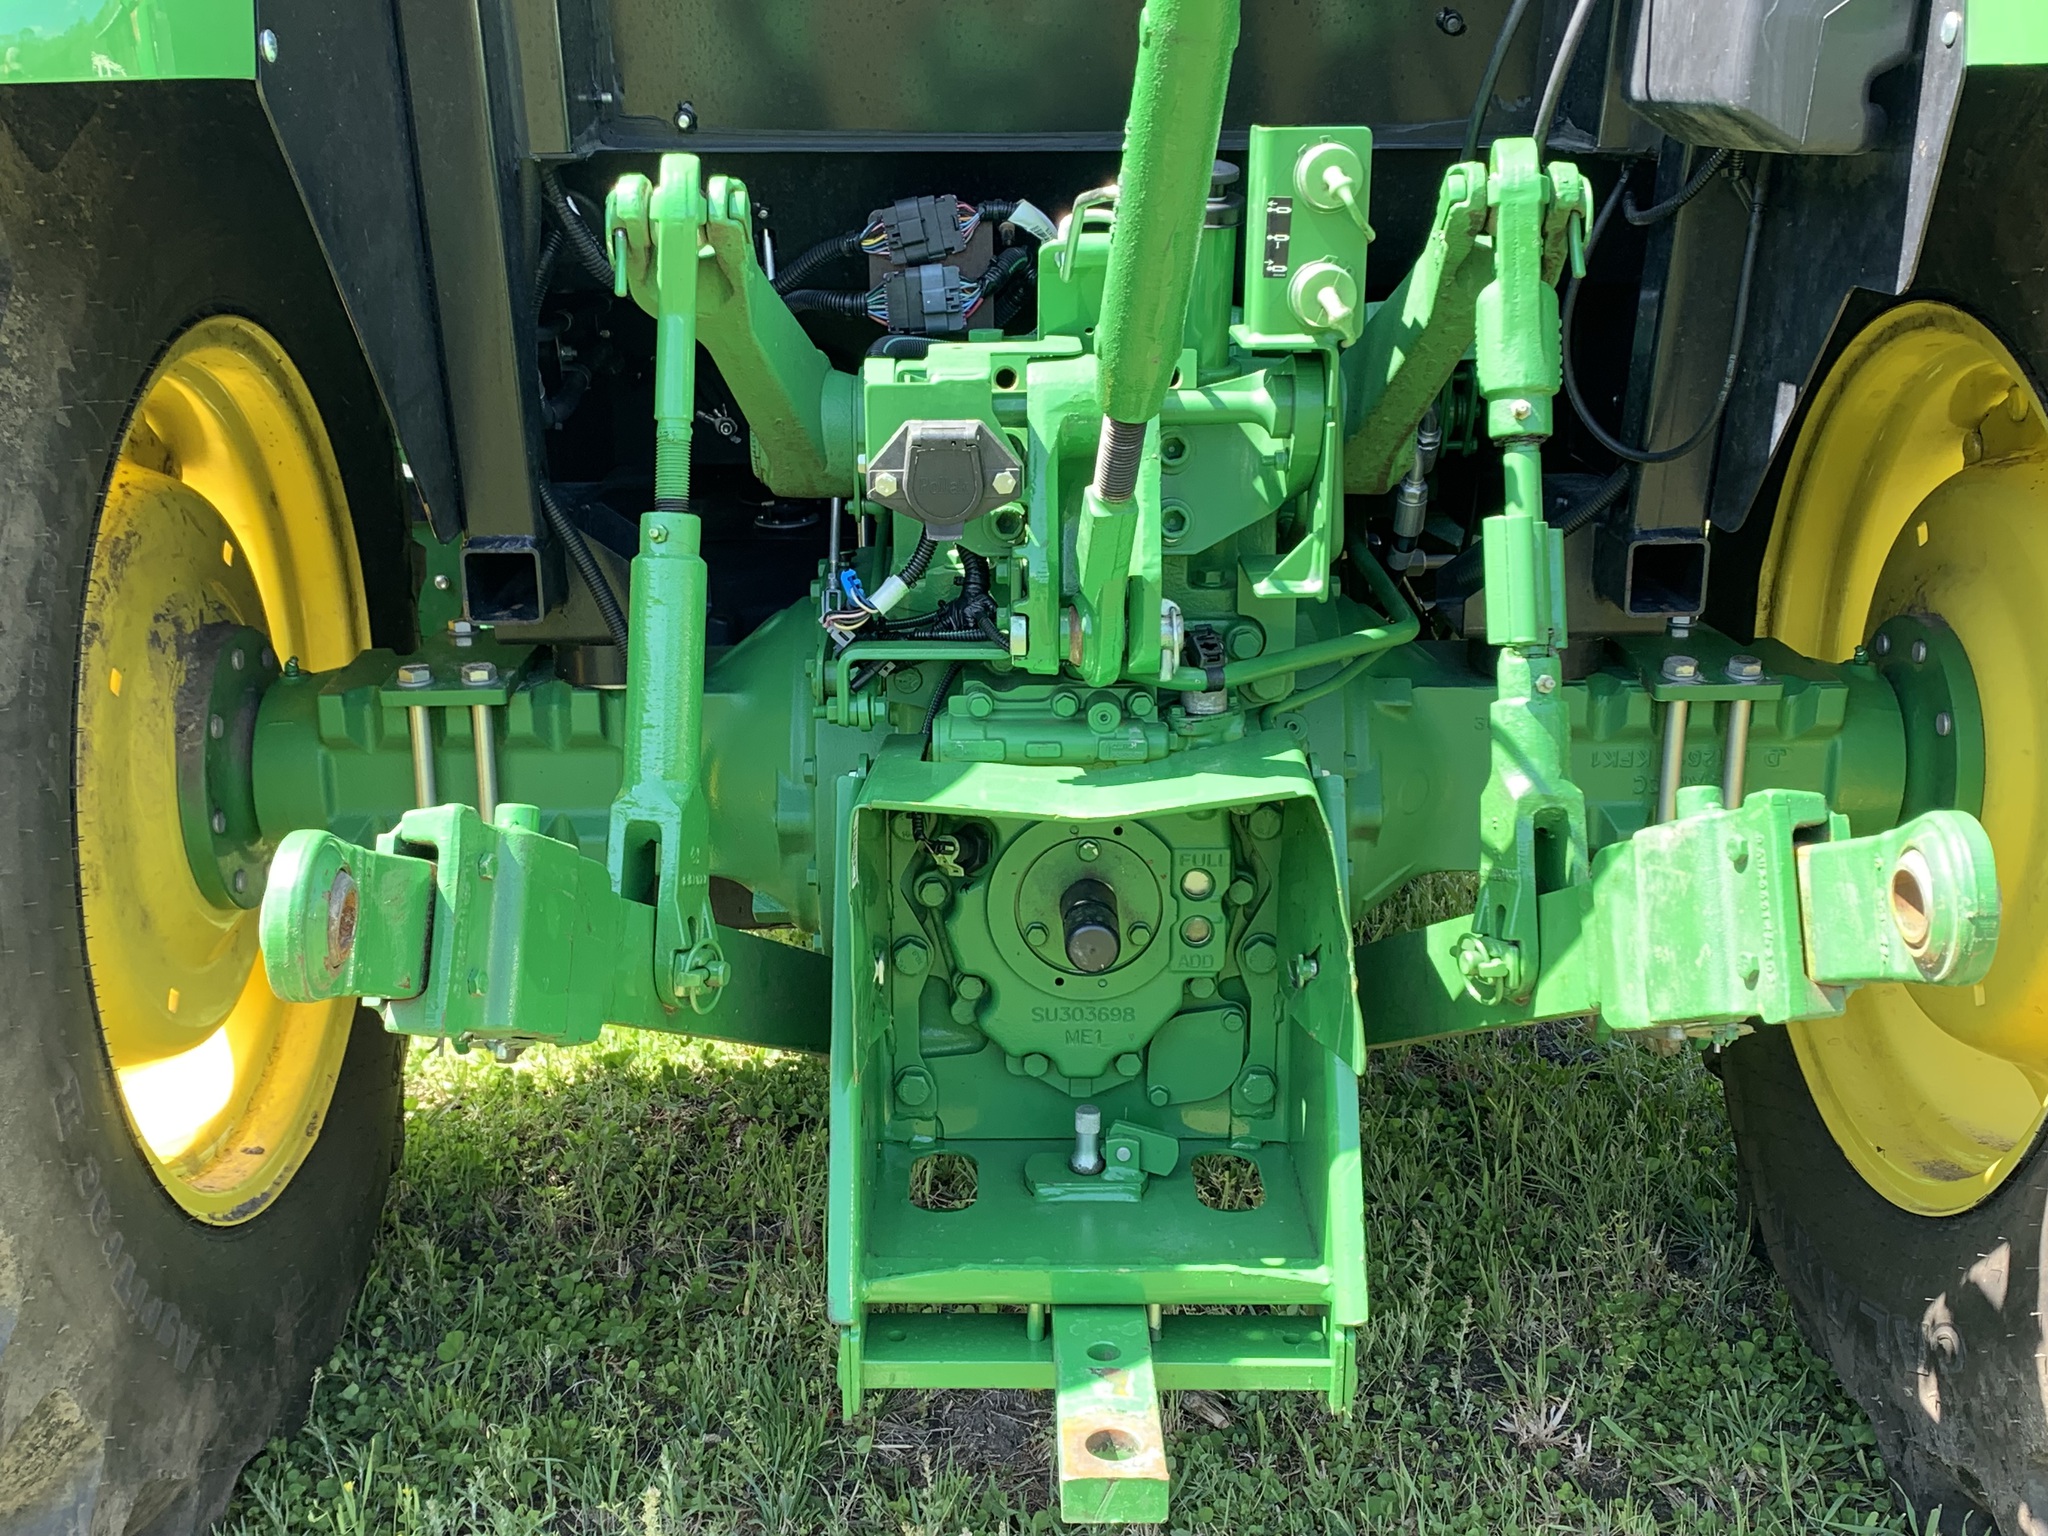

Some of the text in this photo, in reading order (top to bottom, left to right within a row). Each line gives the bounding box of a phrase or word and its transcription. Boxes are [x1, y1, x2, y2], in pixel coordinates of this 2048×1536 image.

[1180, 853, 1225, 867] FULL
[1180, 954, 1214, 969] ADD
[1031, 1006, 1136, 1022] SU303698
[1065, 1029, 1103, 1044] ME1
